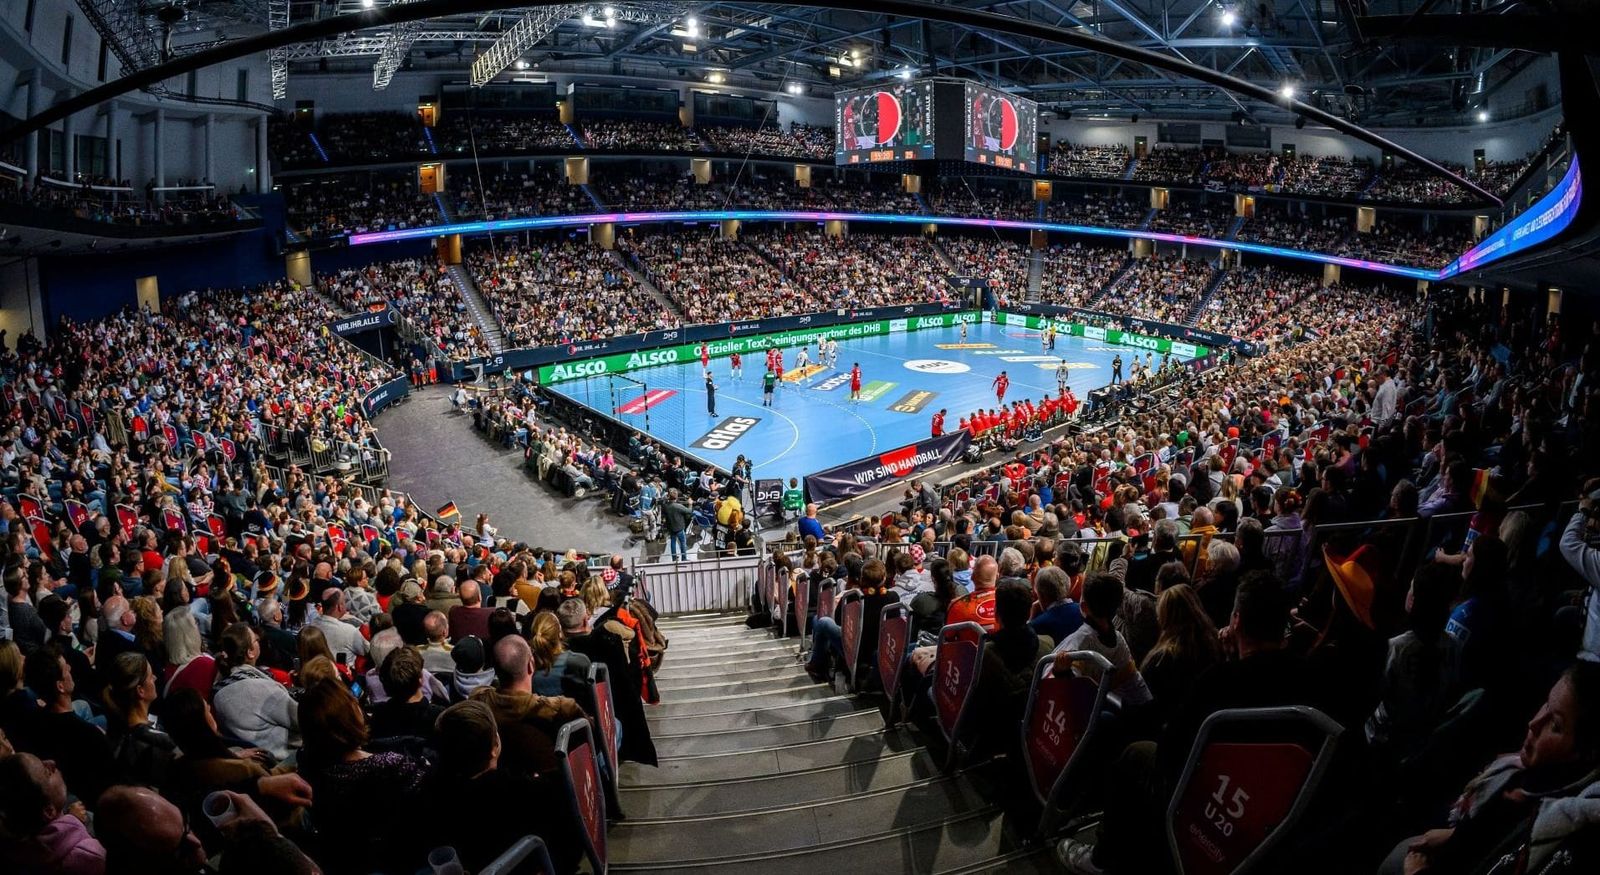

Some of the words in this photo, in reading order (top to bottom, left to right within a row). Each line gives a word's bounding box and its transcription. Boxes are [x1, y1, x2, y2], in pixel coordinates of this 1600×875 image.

[916, 316, 943, 328] ALSCO
[693, 342, 743, 357] Ofizieller
[848, 327, 862, 335] des
[863, 323, 881, 333] DHB
[1119, 332, 1158, 349] ALSCO
[625, 349, 678, 368] ALSCO
[549, 361, 607, 381] ALSCO
[702, 417, 756, 450] atlas
[854, 470, 875, 485] WIR
[876, 462, 898, 478] SIND
[898, 448, 942, 471] HANDBALL
[756, 490, 780, 501] DHB
[887, 632, 896, 654] 12
[947, 660, 960, 685] 13
[1046, 700, 1067, 733] 14
[1210, 774, 1249, 819] 15
